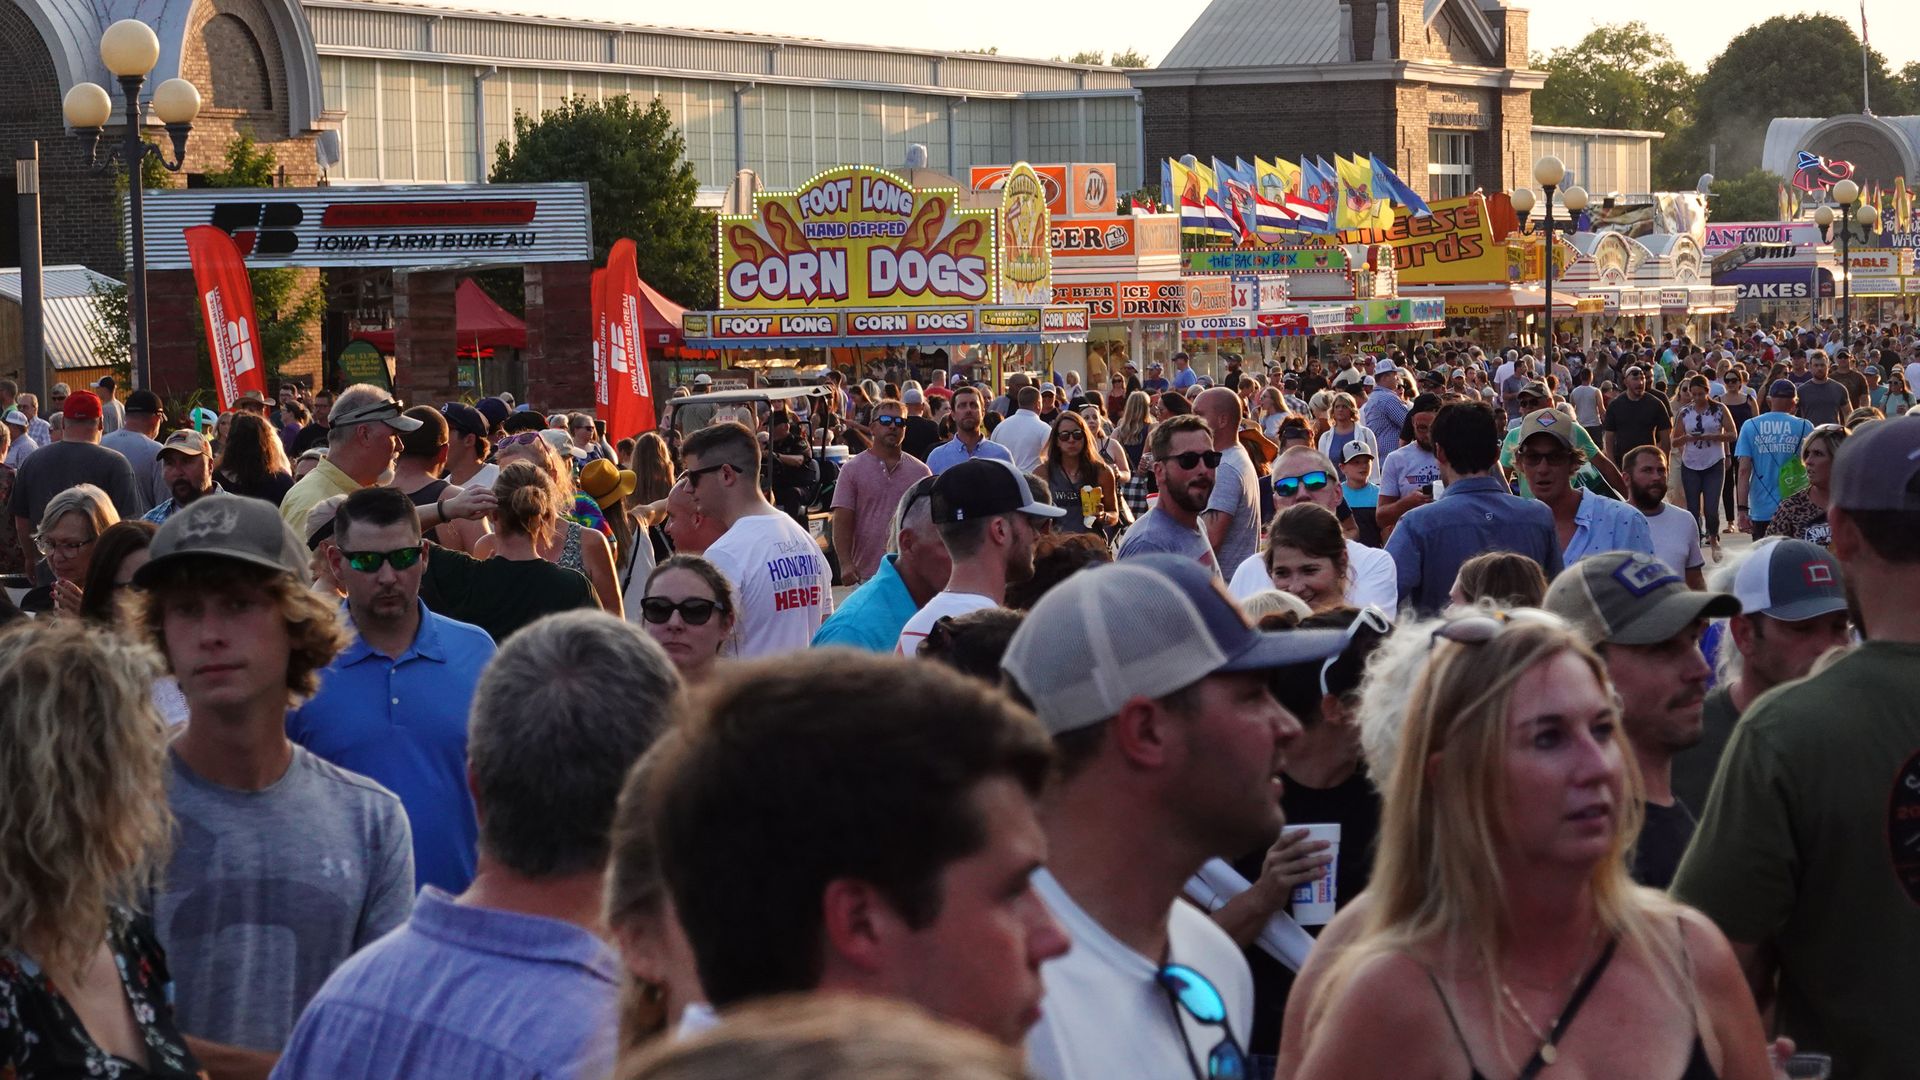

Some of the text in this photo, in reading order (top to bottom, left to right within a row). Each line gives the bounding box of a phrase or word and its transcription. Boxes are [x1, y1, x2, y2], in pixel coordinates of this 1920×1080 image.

[798, 176, 913, 219] FOOT LONG
[804, 222, 848, 239] HAND
[1051, 228, 1103, 249] EER
[315, 231, 537, 250] IOWA FARM BUREAU
[1394, 232, 1485, 271] urds
[1208, 252, 1298, 268] THE BACON BOX
[1851, 257, 1889, 268] ABLE
[727, 245, 988, 305] CORN DOGS
[1072, 287, 1113, 297] BEER
[1123, 286, 1149, 298] ICE
[1158, 285, 1185, 298] COLD
[1737, 283, 1807, 298] CAKES
[1123, 300, 1186, 314] DRINKS
[1463, 304, 1489, 314] Curds
[622, 293, 633, 338] BUREAU
[854, 313, 968, 332] CORN DOGS
[984, 313, 1037, 327] Lemonade
[1043, 311, 1085, 329] CORN DOGS
[1201, 317, 1246, 328] CONES
[720, 316, 772, 334] FOOT
[780, 316, 832, 333] LONG
[627, 338, 638, 370] FARM
[632, 372, 641, 395] IOWA
[1760, 420, 1792, 435] IOWA
[1778, 433, 1800, 444] Fair
[1758, 443, 1796, 454] VOLUNTEER
